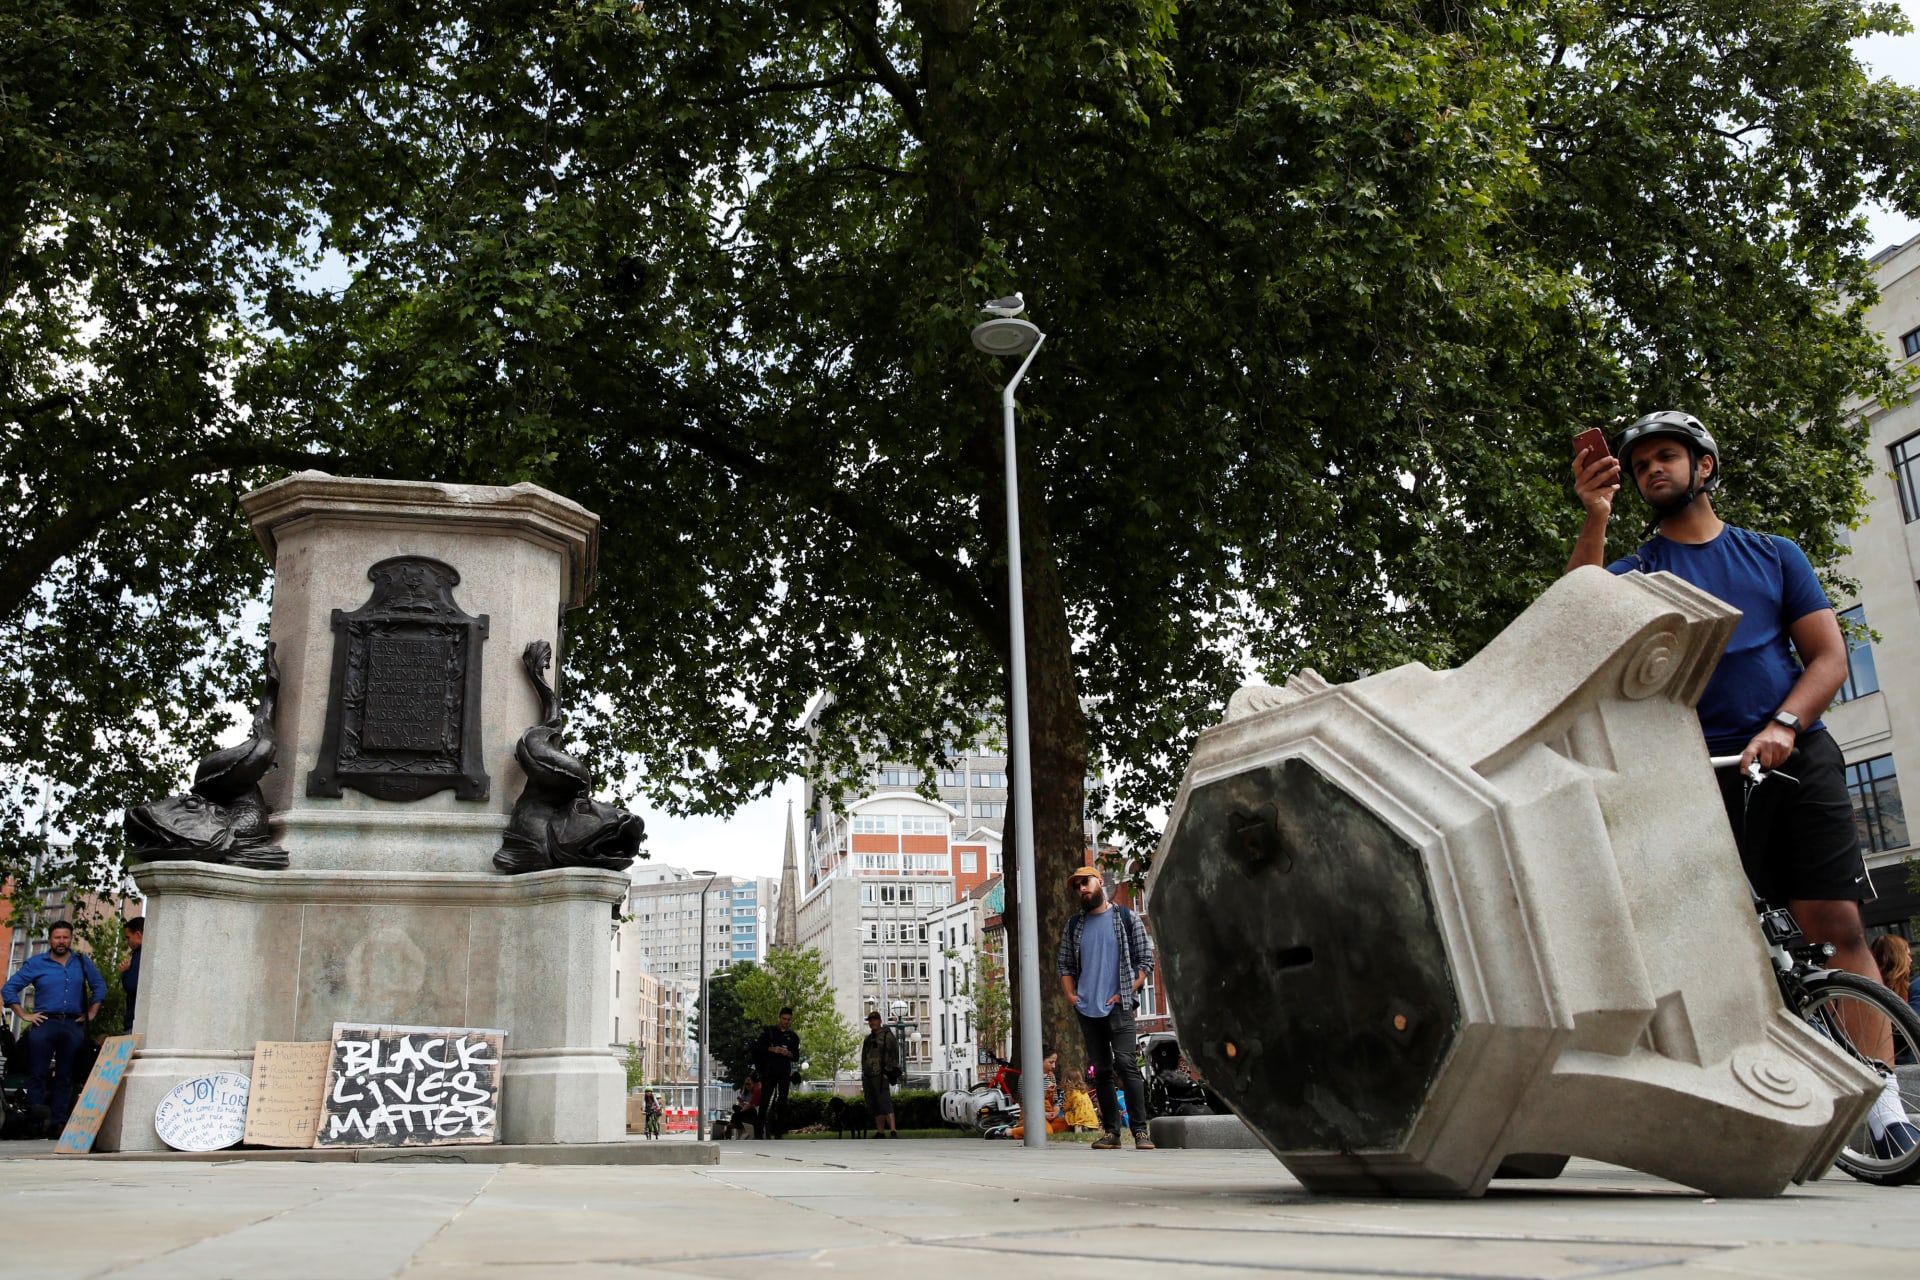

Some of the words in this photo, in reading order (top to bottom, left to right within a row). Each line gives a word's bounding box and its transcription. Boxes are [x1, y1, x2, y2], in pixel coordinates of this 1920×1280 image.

[373, 640, 428, 654] ERECTED
[399, 709, 425, 722] SONS
[337, 1035, 498, 1076] BLACK
[157, 1101, 174, 1124] Sing
[173, 1083, 185, 1099] for
[183, 1075, 219, 1106] JOY
[219, 1075, 230, 1086] to
[233, 1075, 248, 1090] the
[331, 1069, 491, 1107] LIVES
[329, 1103, 497, 1139] MATTER
